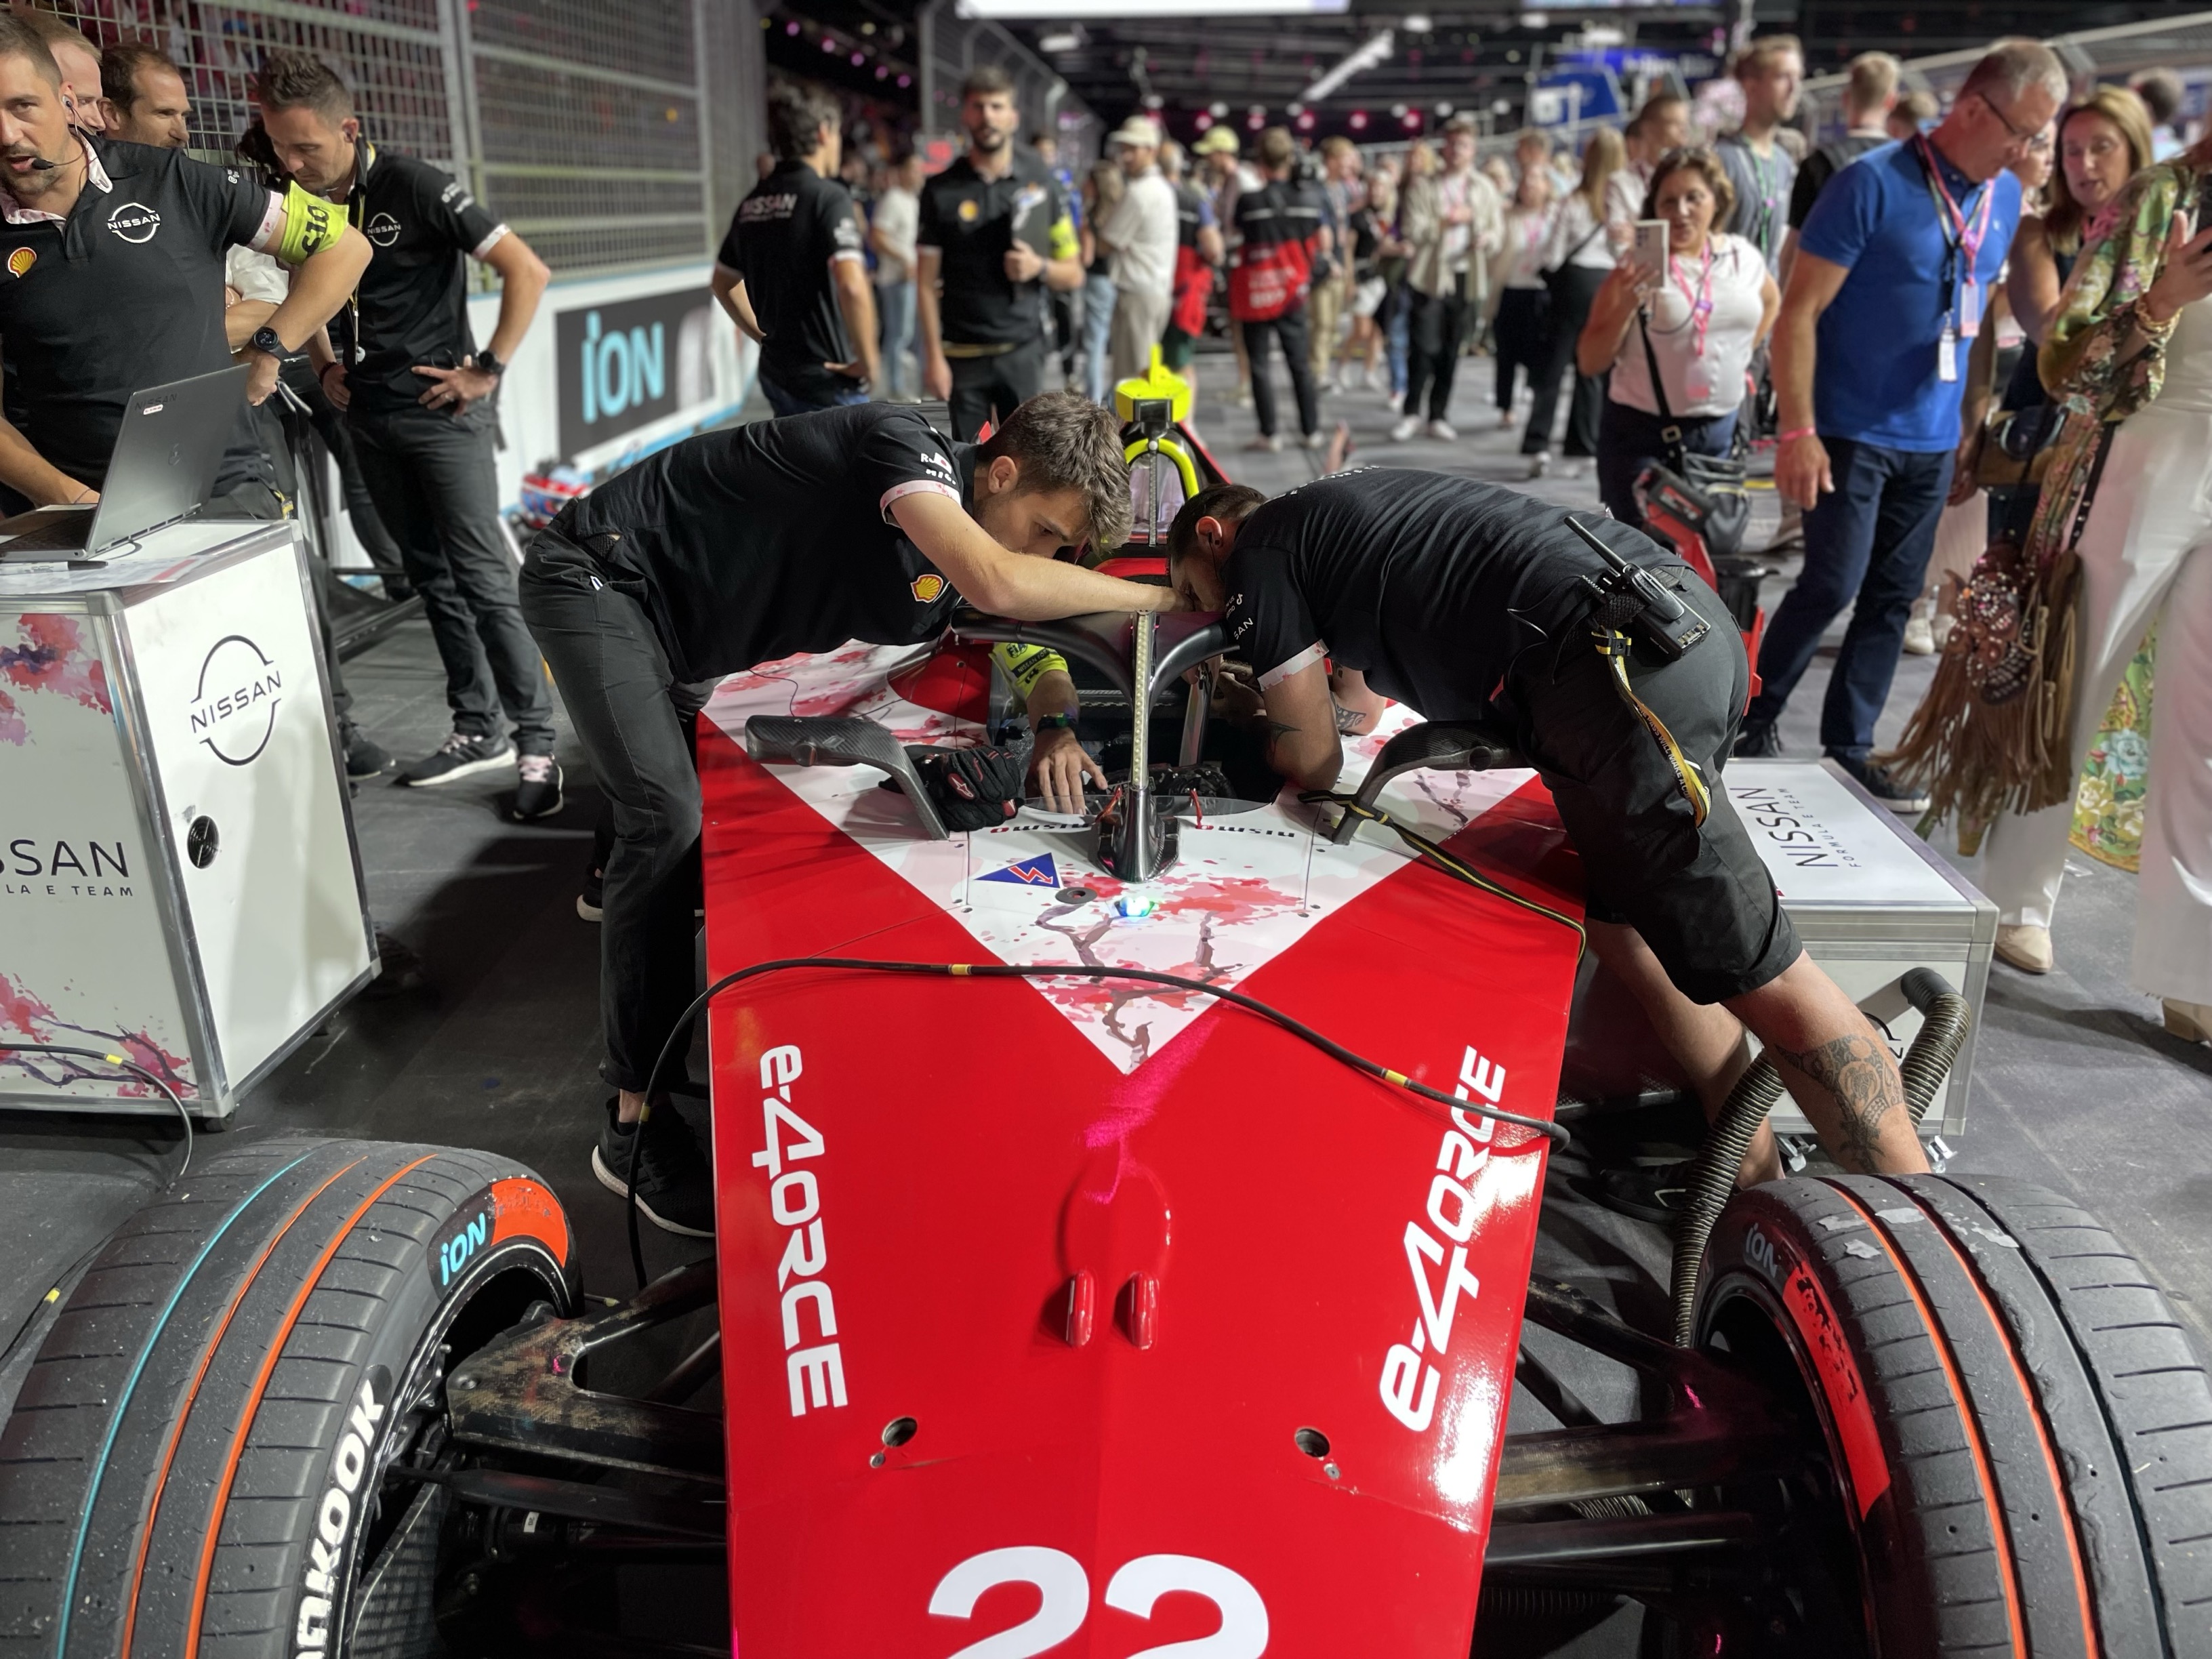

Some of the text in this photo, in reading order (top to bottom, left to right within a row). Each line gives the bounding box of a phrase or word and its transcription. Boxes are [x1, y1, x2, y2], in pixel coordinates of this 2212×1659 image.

[107, 213, 161, 230] NISSAN
[367, 224, 401, 235] NISSAN
[581, 309, 665, 424] iON
[134, 393, 178, 411] NISSAN
[1233, 617, 1254, 640] SAN
[1017, 648, 1048, 674] NISSAN FOR
[190, 670, 282, 734] NISSAN
[1658, 735, 1671, 754] WILL
[1668, 753, 1683, 779] MAKE
[1778, 788, 1805, 809] TEAM
[1729, 787, 1839, 867] NISSAN
[1811, 823, 1862, 867] FORMULA
[0, 839, 129, 878] SAN
[5, 884, 134, 897] LA E TEAM
[440, 1212, 486, 1286] iON
[1745, 1222, 1778, 1278] iON
[928, 1546, 1269, 1659] 22
